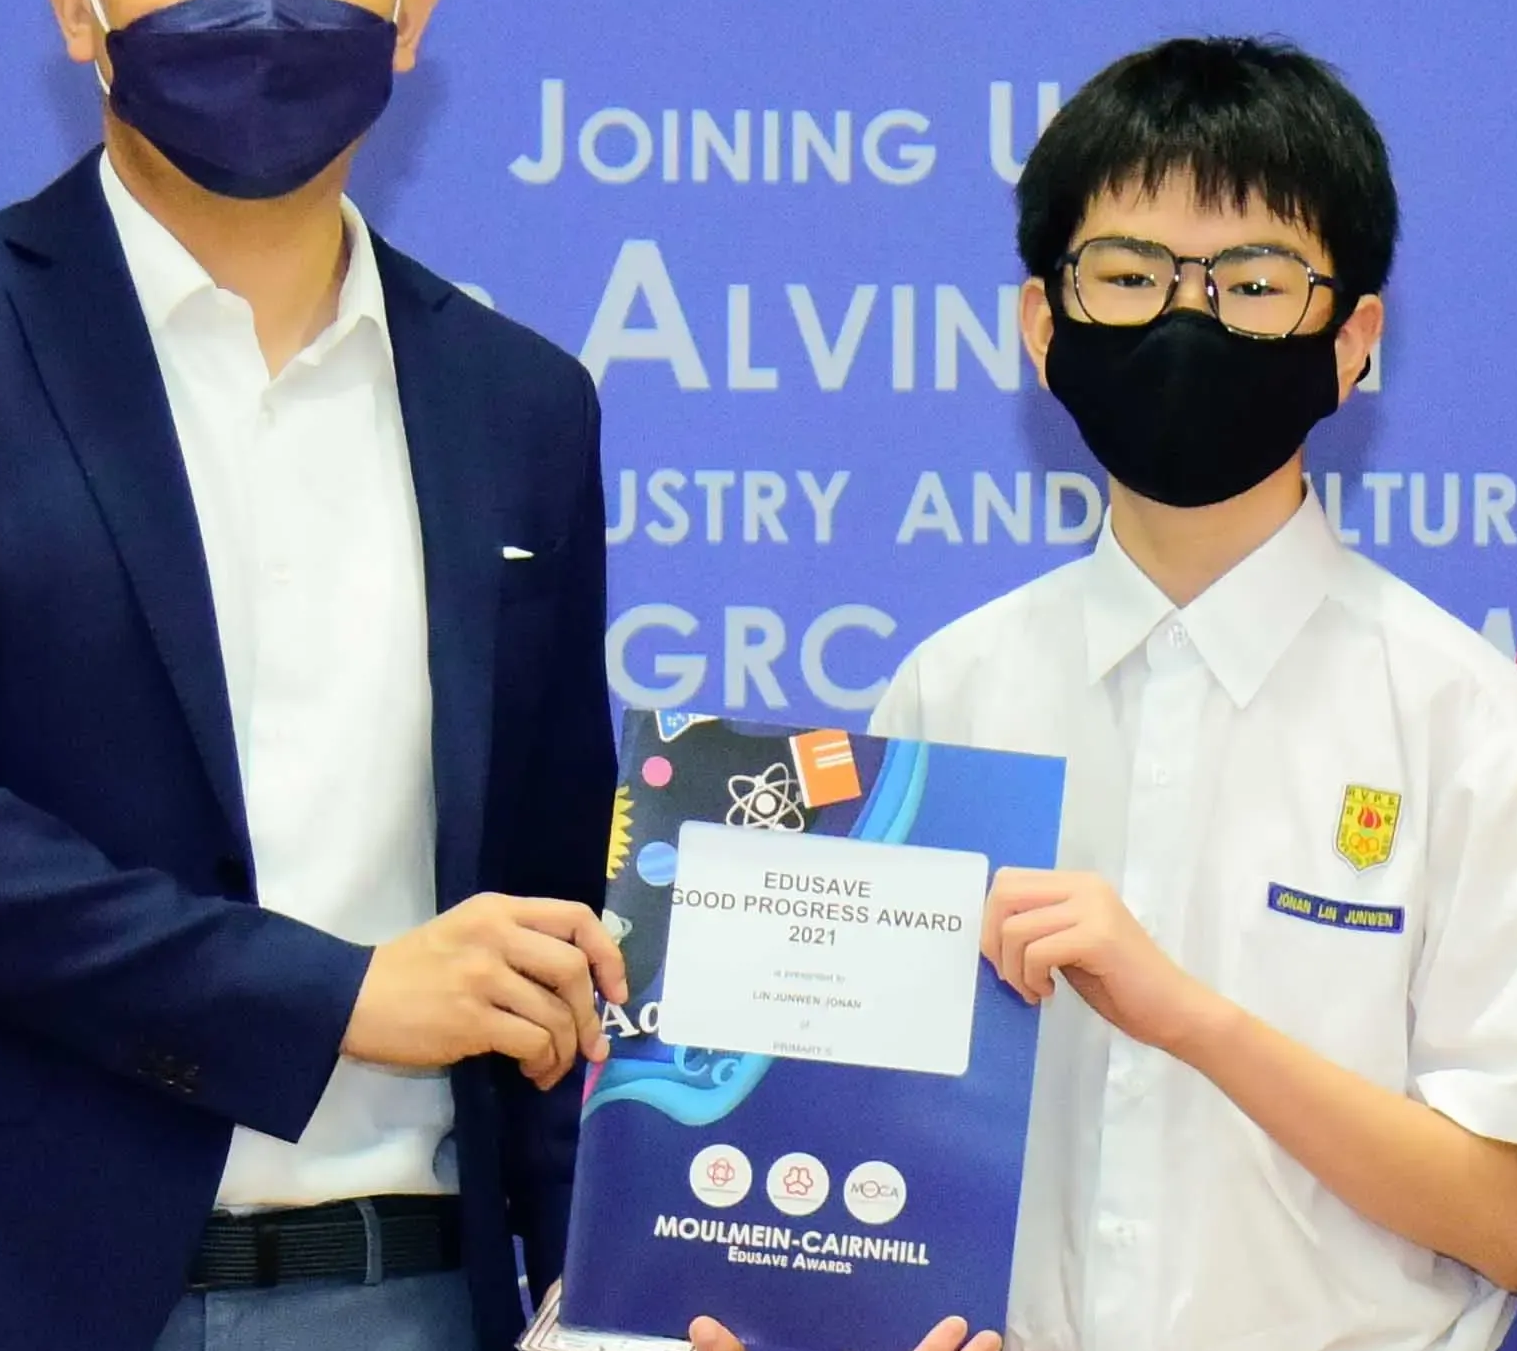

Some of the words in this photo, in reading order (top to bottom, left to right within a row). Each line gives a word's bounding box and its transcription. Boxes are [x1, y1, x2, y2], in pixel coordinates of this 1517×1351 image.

[508, 78, 937, 186] JOINING
[578, 239, 1021, 392] ALVIN
[896, 470, 1103, 544] AND
[604, 603, 898, 711] GRC
[671, 886, 737, 911] GOOD
[743, 894, 870, 924] PROGRESS
[876, 908, 963, 933] AWARD
[764, 870, 872, 899] EDUSAVE
[788, 925, 837, 947] 2021
[653, 1214, 931, 1266] MOULMEIN-CAIRNHILL
[727, 1245, 789, 1269] EDUSAVE
[792, 1252, 853, 1276] AWARDS
